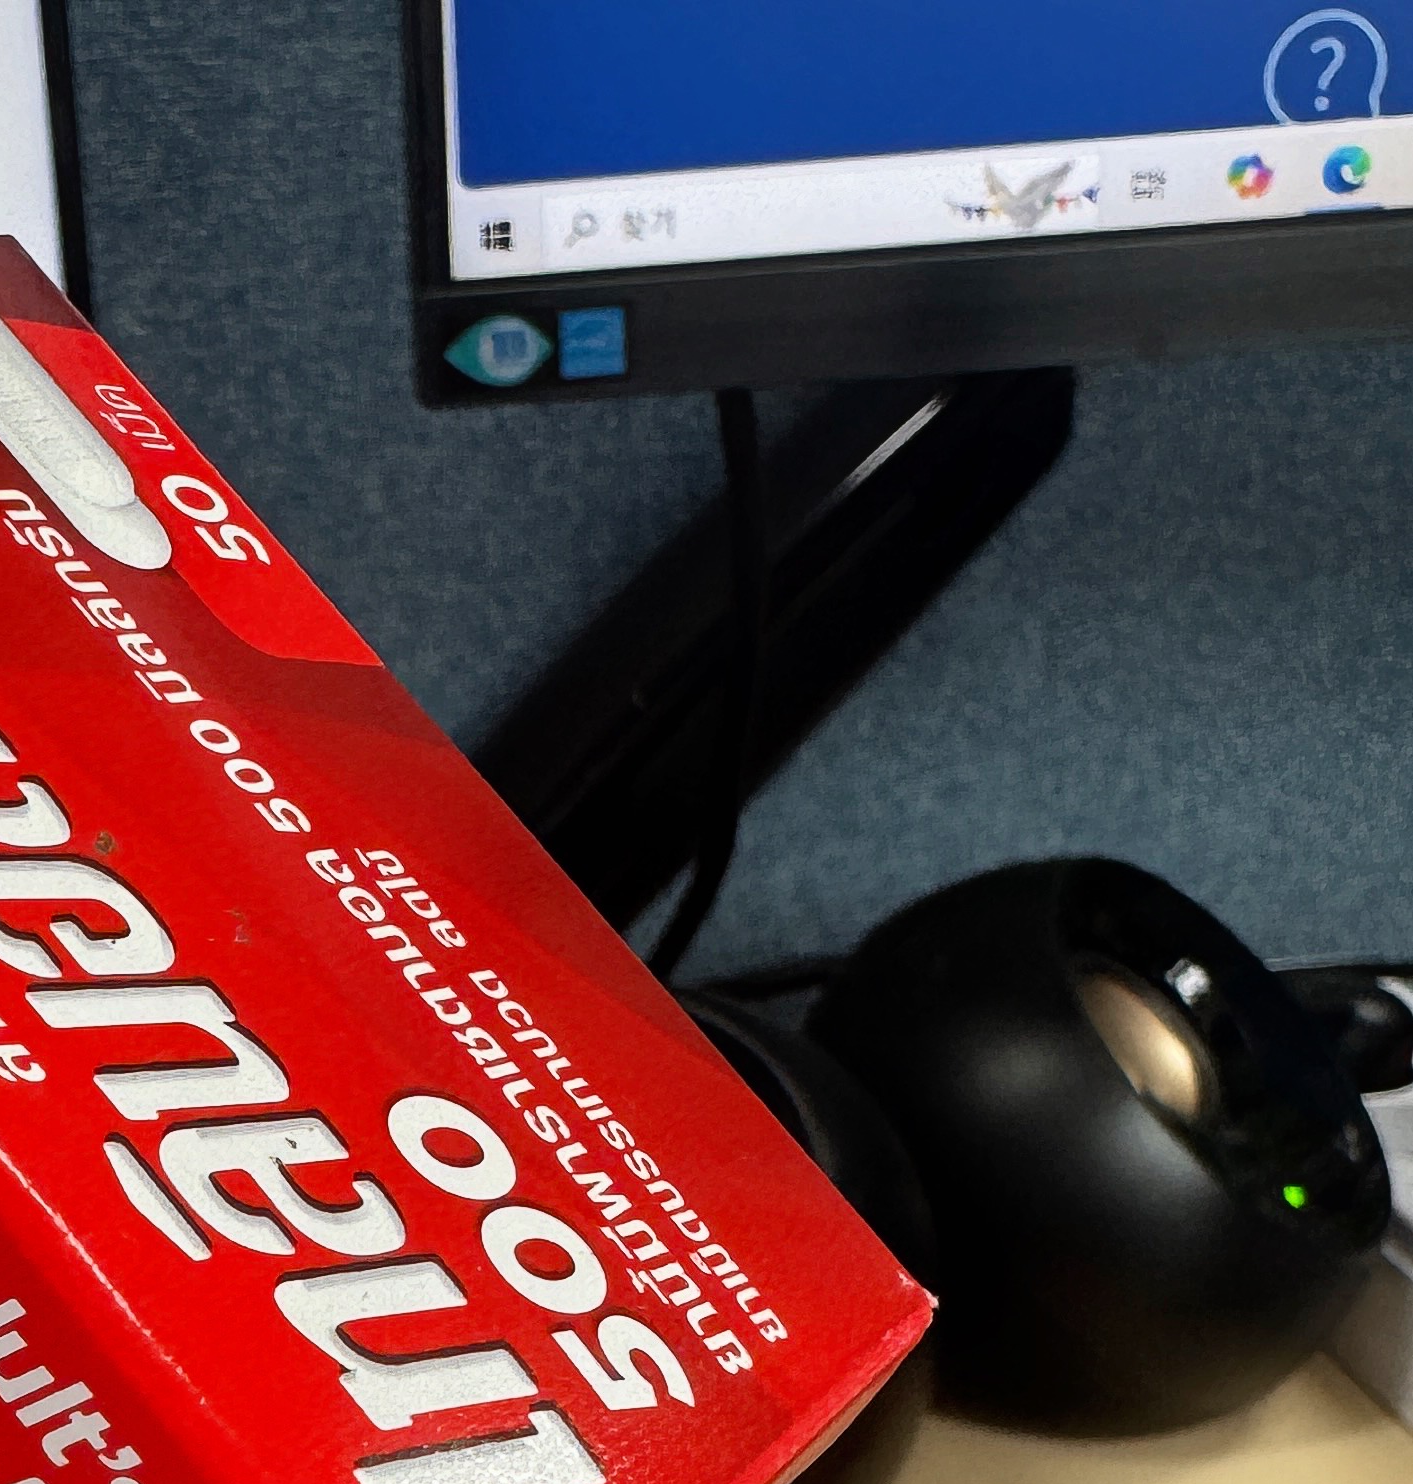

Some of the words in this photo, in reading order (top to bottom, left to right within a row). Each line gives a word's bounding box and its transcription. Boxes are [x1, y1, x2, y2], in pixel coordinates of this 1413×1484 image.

[95, 385, 175, 450] เม็ด
[165, 475, 270, 565] 50
[190, 720, 311, 832] 500
[355, 848, 467, 947] ลดไข้
[468, 970, 787, 1342] ยาเม็ดบรรเทาปวด
[388, 1096, 695, 1410] 500
